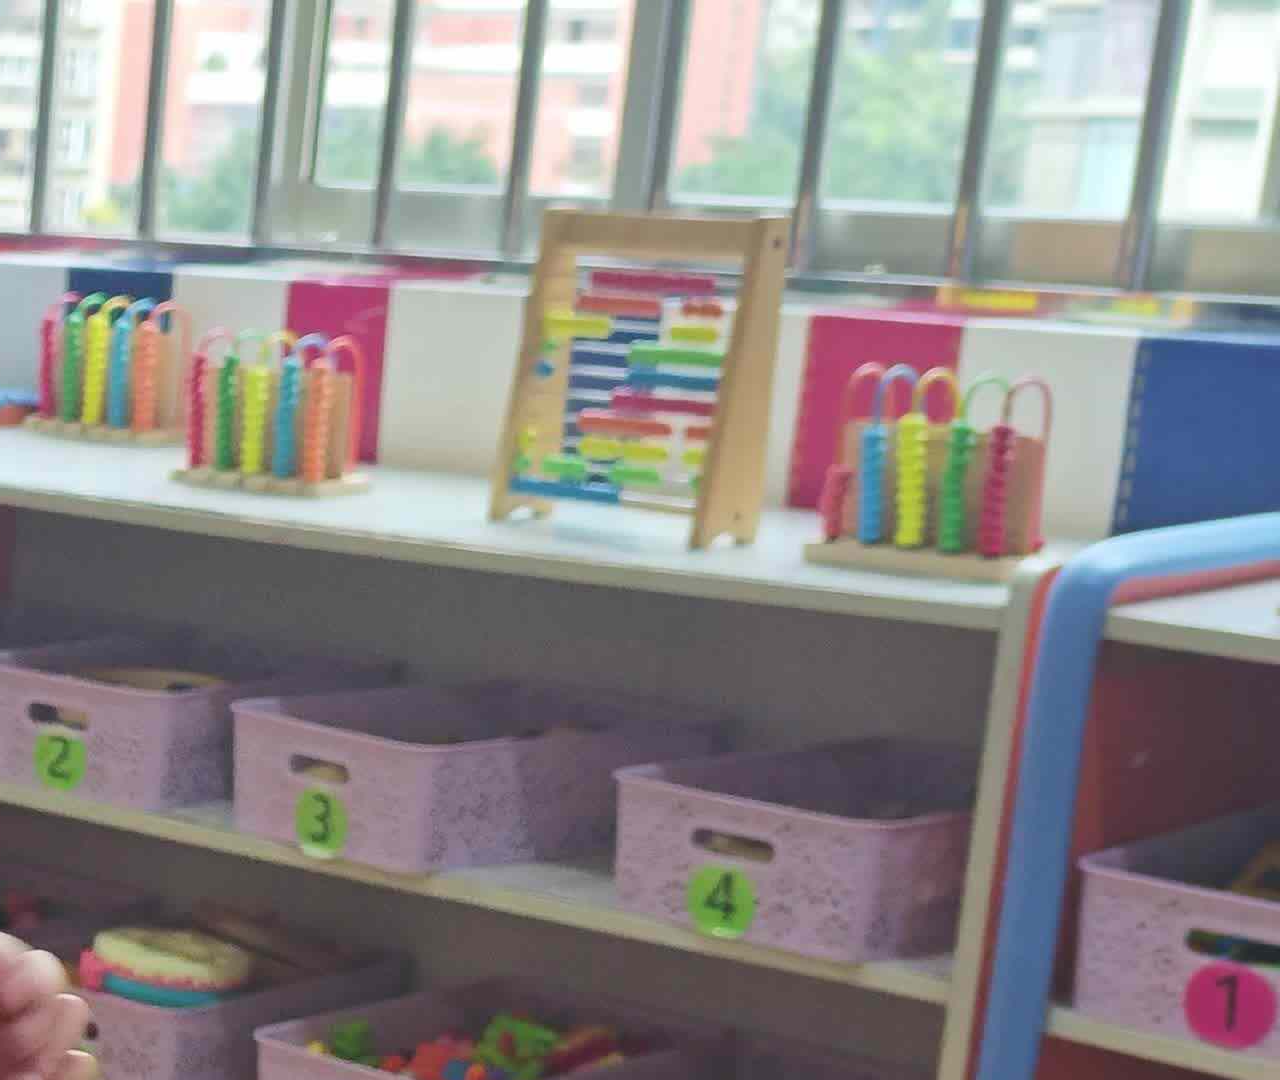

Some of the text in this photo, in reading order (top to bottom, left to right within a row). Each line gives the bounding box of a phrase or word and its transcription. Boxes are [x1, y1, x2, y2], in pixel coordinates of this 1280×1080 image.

[47, 736, 71, 780] 2
[309, 793, 331, 843] 3
[703, 871, 737, 921] 4
[1214, 974, 1239, 1034] 1
